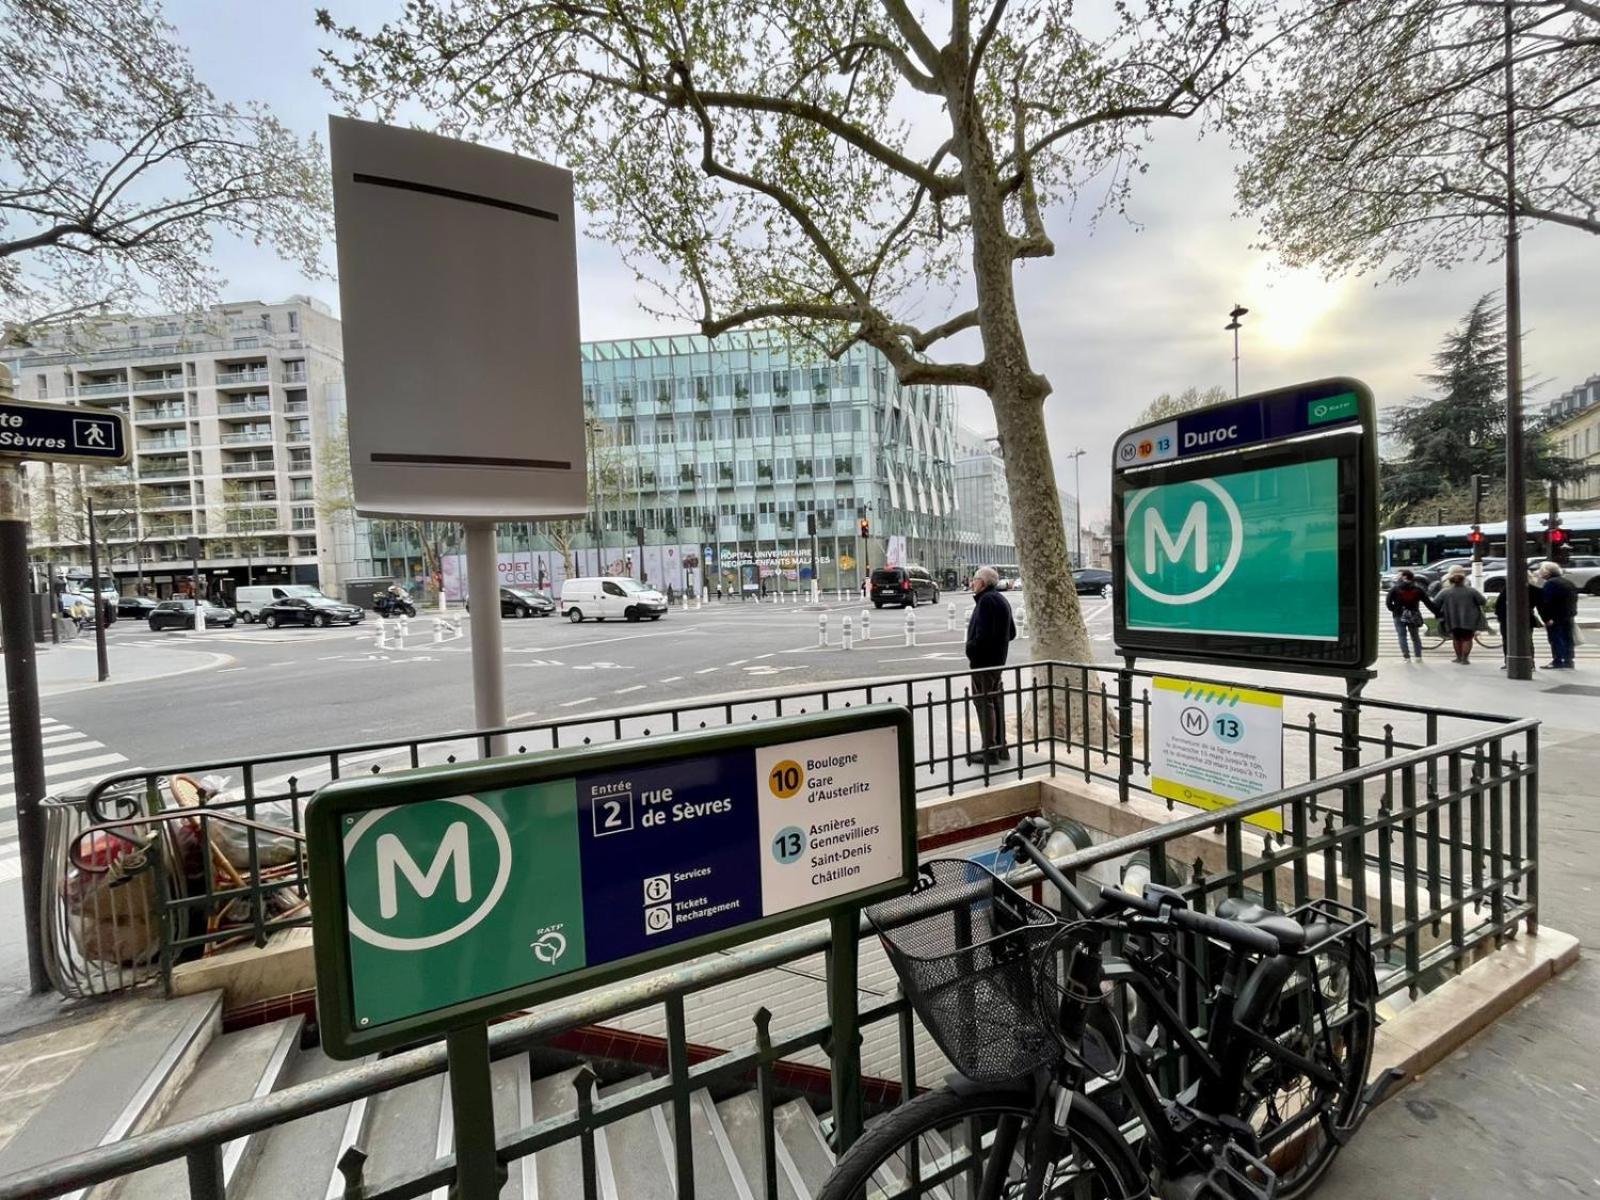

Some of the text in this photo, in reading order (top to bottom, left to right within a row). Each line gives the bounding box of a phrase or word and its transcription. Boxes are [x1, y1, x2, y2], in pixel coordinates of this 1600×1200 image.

[0, 432, 66, 449] Sèvres
[1184, 425, 1238, 448] Duroc
[1139, 443, 1152, 455] 10
[1158, 438, 1170, 451] 13
[754, 548, 812, 559] UNIVERSITAIRE
[498, 562, 529, 572] OJET
[1216, 719, 1239, 738] 13
[806, 753, 858, 771] Boulogne
[591, 781, 632, 796] Entrée
[772, 767, 799, 792] 10
[807, 776, 833, 789] Gare
[641, 788, 673, 806] rue
[807, 782, 870, 803] d'Austerlitz
[603, 801, 622, 828] 2
[641, 798, 732, 828] de Sèvres
[809, 817, 857, 836] Asnières
[775, 833, 802, 858] 13
[810, 825, 880, 850] Gennevilliers
[811, 843, 873, 868] Saint-Denis
[673, 866, 712, 883] Services
[811, 865, 861, 886] Châtillon
[675, 897, 708, 911] Tickets
[675, 899, 740, 924] Rechargement
[536, 923, 564, 935] RATP
